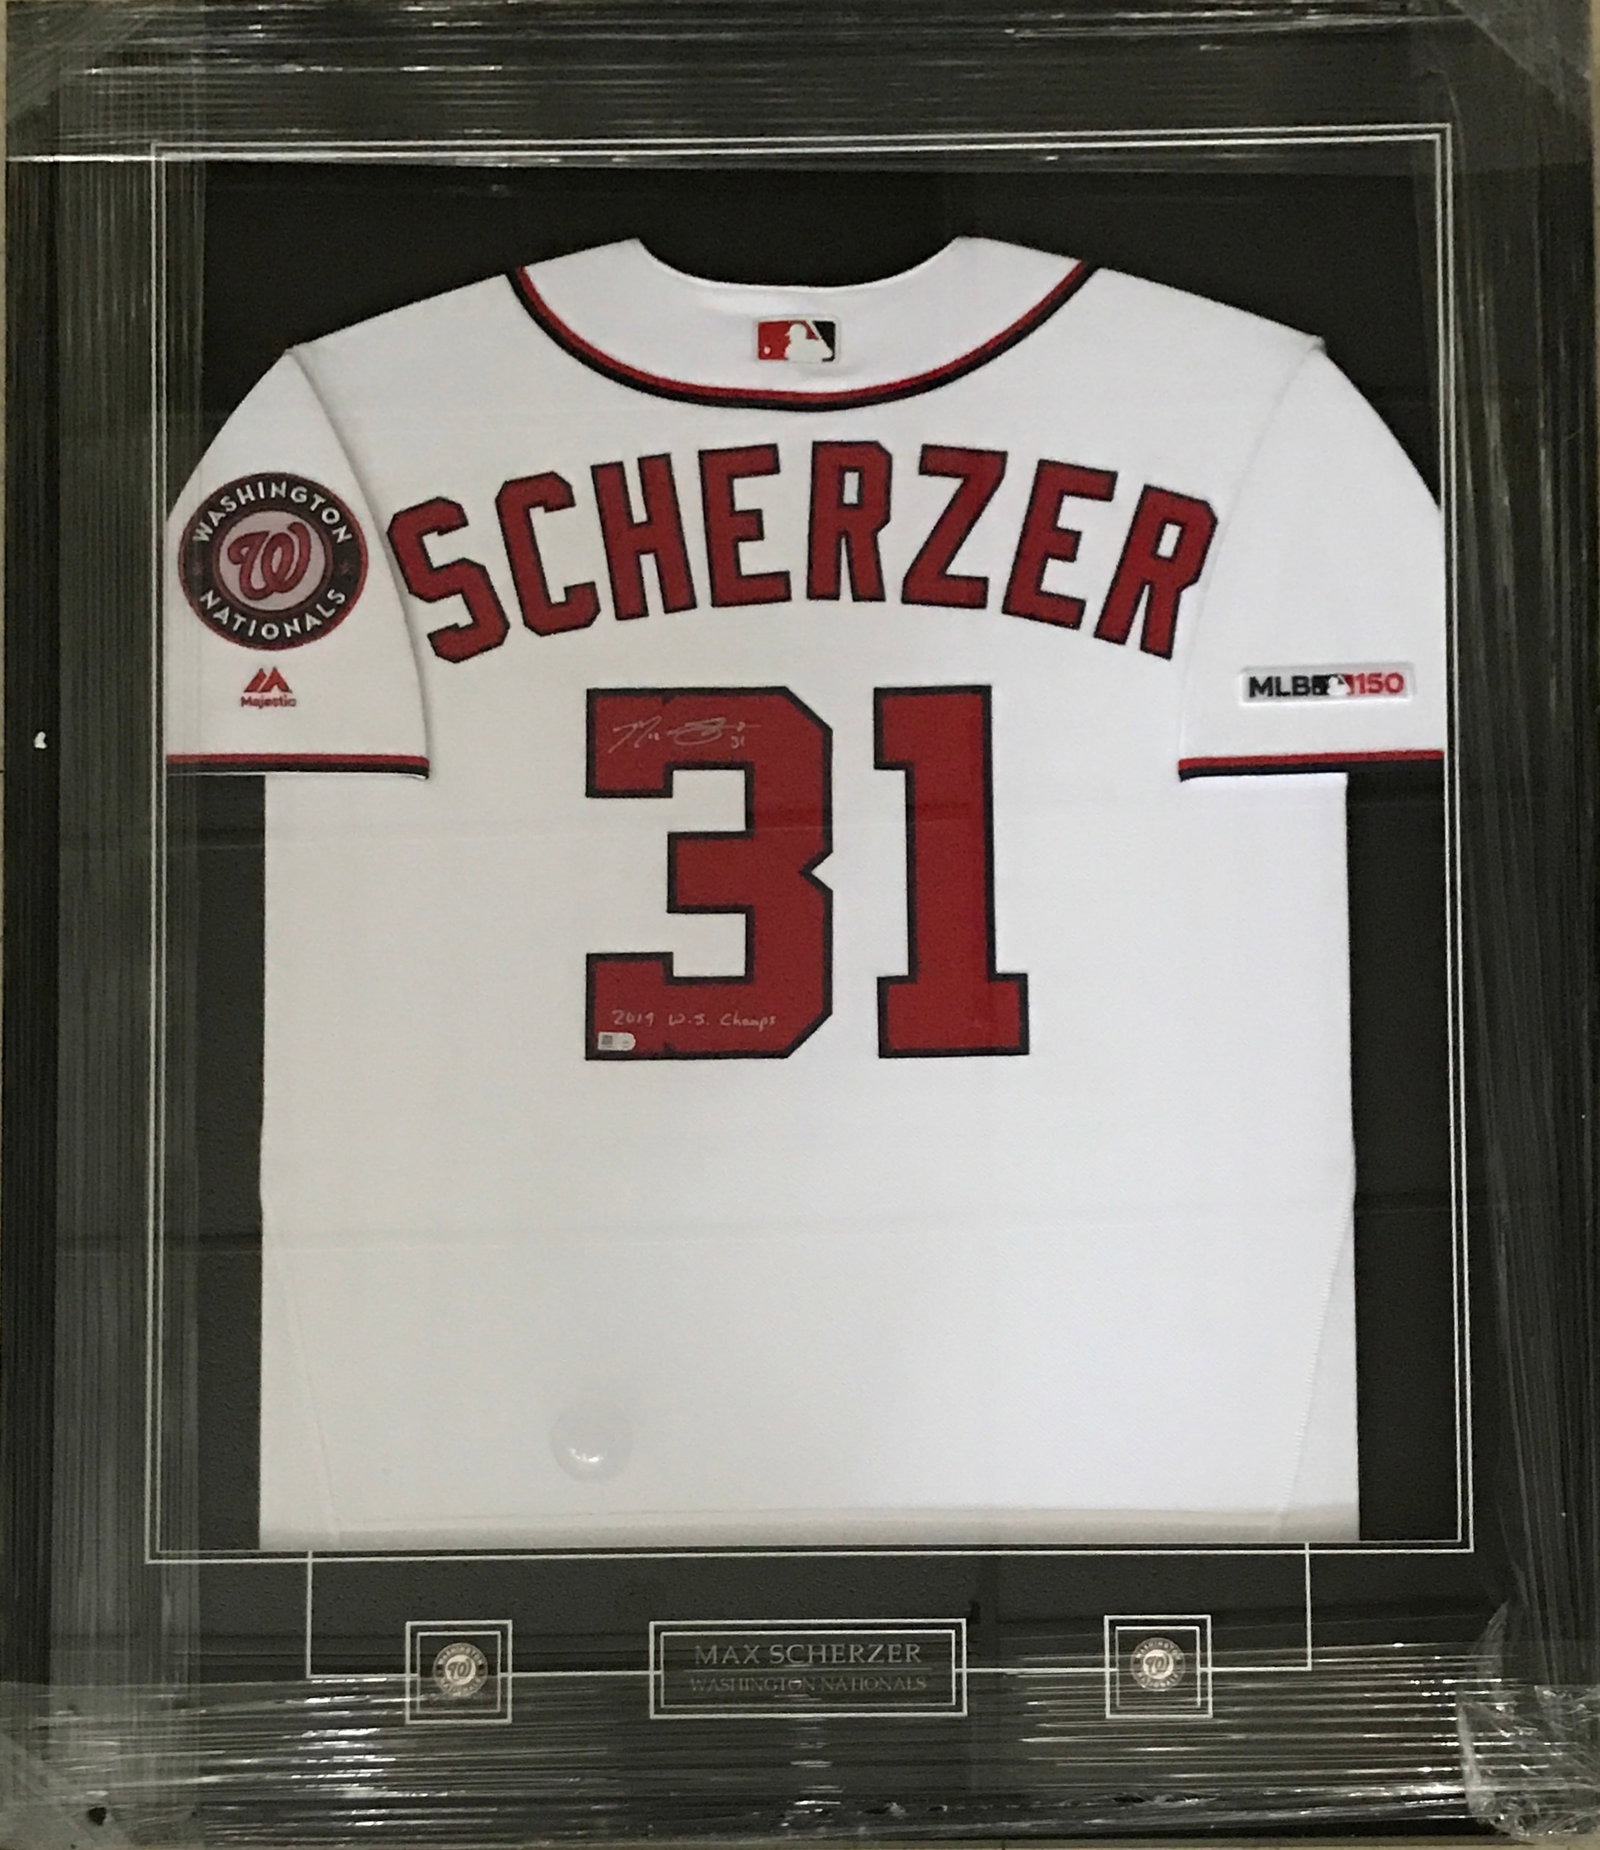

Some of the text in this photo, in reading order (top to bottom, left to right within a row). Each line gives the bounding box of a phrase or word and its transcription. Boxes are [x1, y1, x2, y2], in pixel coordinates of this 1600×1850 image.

[192, 480, 353, 544] WASHINGTON
[387, 440, 1218, 664] SCHERZER
[200, 588, 347, 640] NATIONALS
[1249, 672, 1405, 698] MLB 150
[240, 695, 297, 710] Majestic
[586, 685, 1030, 1061] 31
[611, 1009, 655, 1027] 2019
[694, 1643, 923, 1665] MAX SCHERZER
[690, 1673, 928, 1693] WASHINGTON NATIONALS
